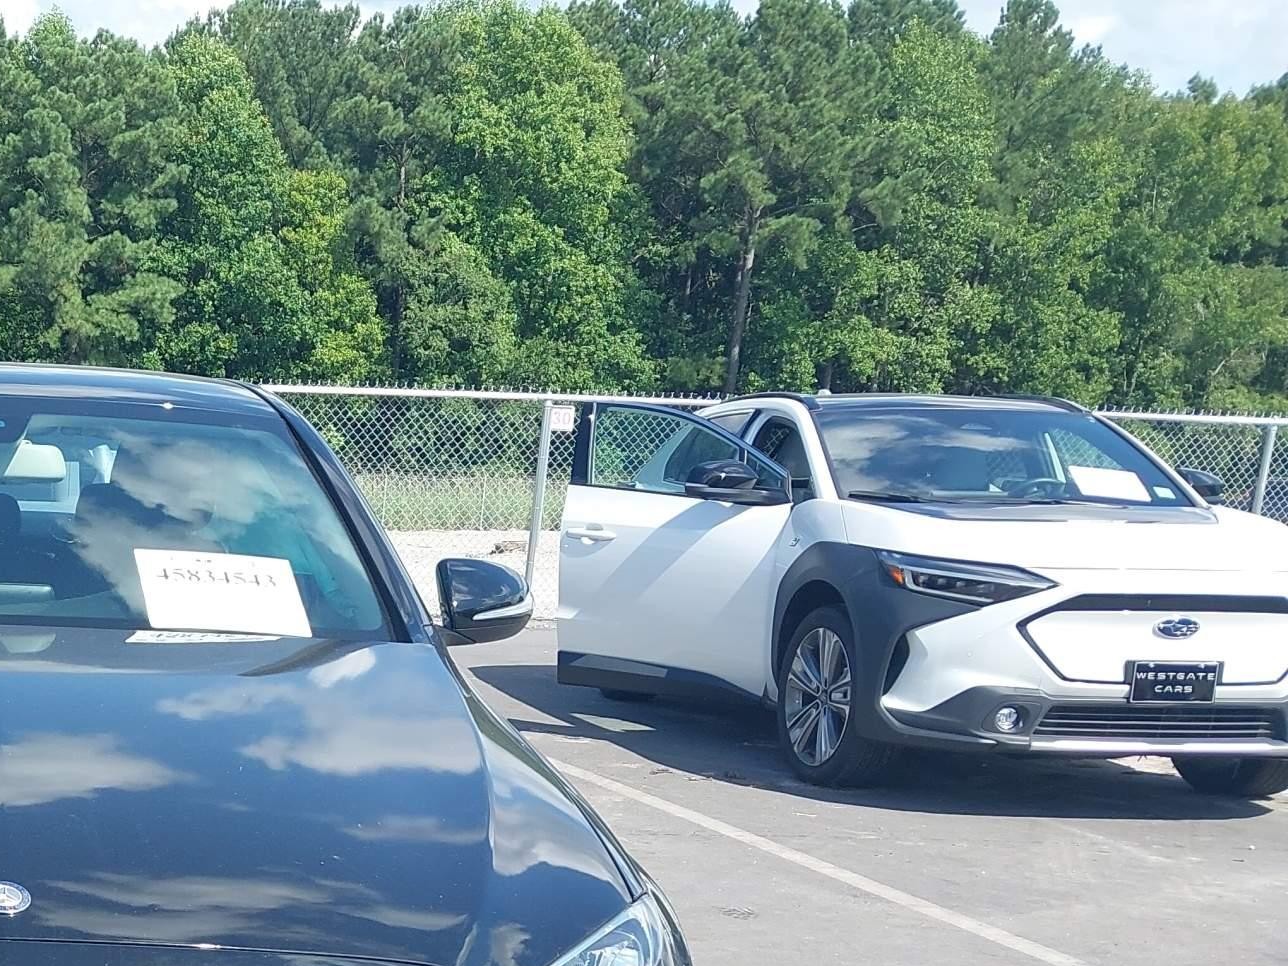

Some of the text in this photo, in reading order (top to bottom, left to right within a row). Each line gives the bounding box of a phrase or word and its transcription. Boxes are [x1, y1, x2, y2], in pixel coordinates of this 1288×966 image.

[553, 411, 571, 425] 30
[154, 568, 278, 588] 45834543
[1136, 672, 1216, 680] WESTGATE
[1154, 685, 1193, 693] CARS
